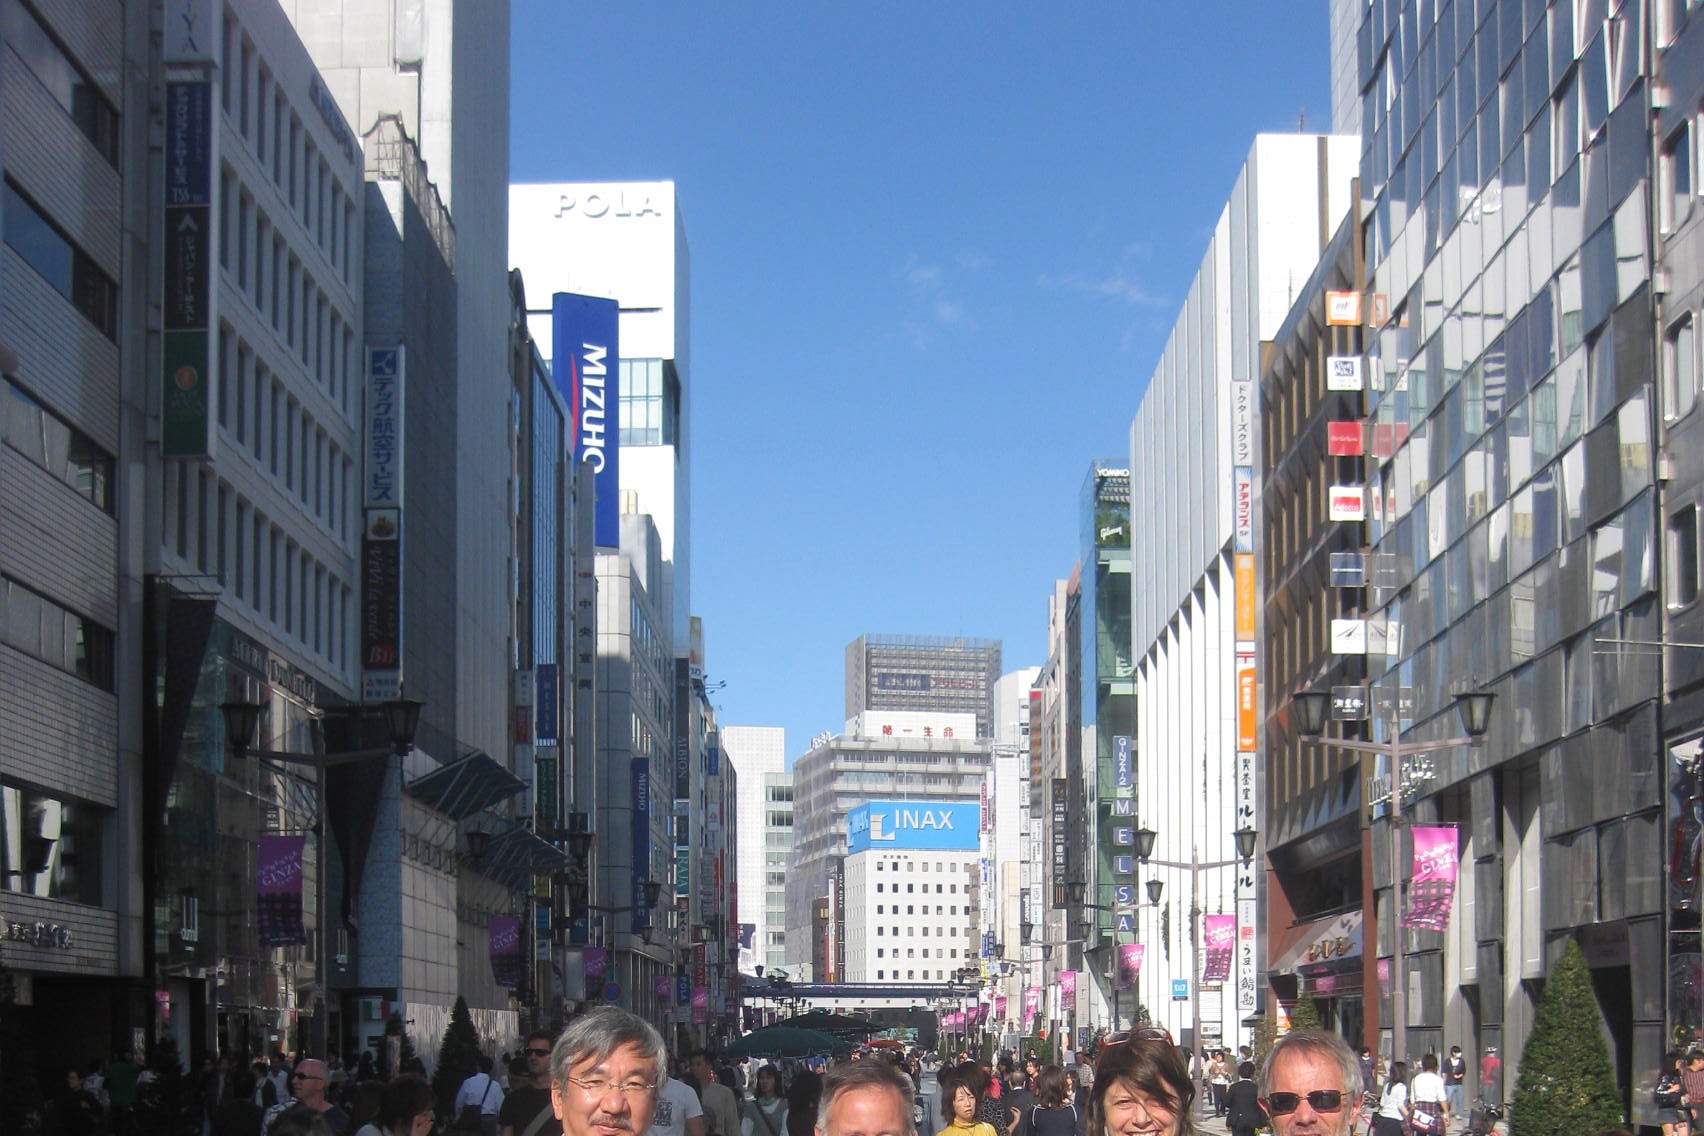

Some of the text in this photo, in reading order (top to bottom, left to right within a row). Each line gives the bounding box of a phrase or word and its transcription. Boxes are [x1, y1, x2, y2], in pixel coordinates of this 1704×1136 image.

[554, 189, 662, 219] POLA
[581, 342, 608, 474] MIZUHO
[372, 377, 394, 501] テック航空サービス
[882, 724, 954, 738] 第一生命
[677, 735, 688, 779] ALBION
[638, 772, 648, 811] MIZUHO
[895, 808, 954, 830] INAX
[1239, 758, 1254, 888] 喫茶室ルル
[1116, 801, 1133, 931] MELSA
